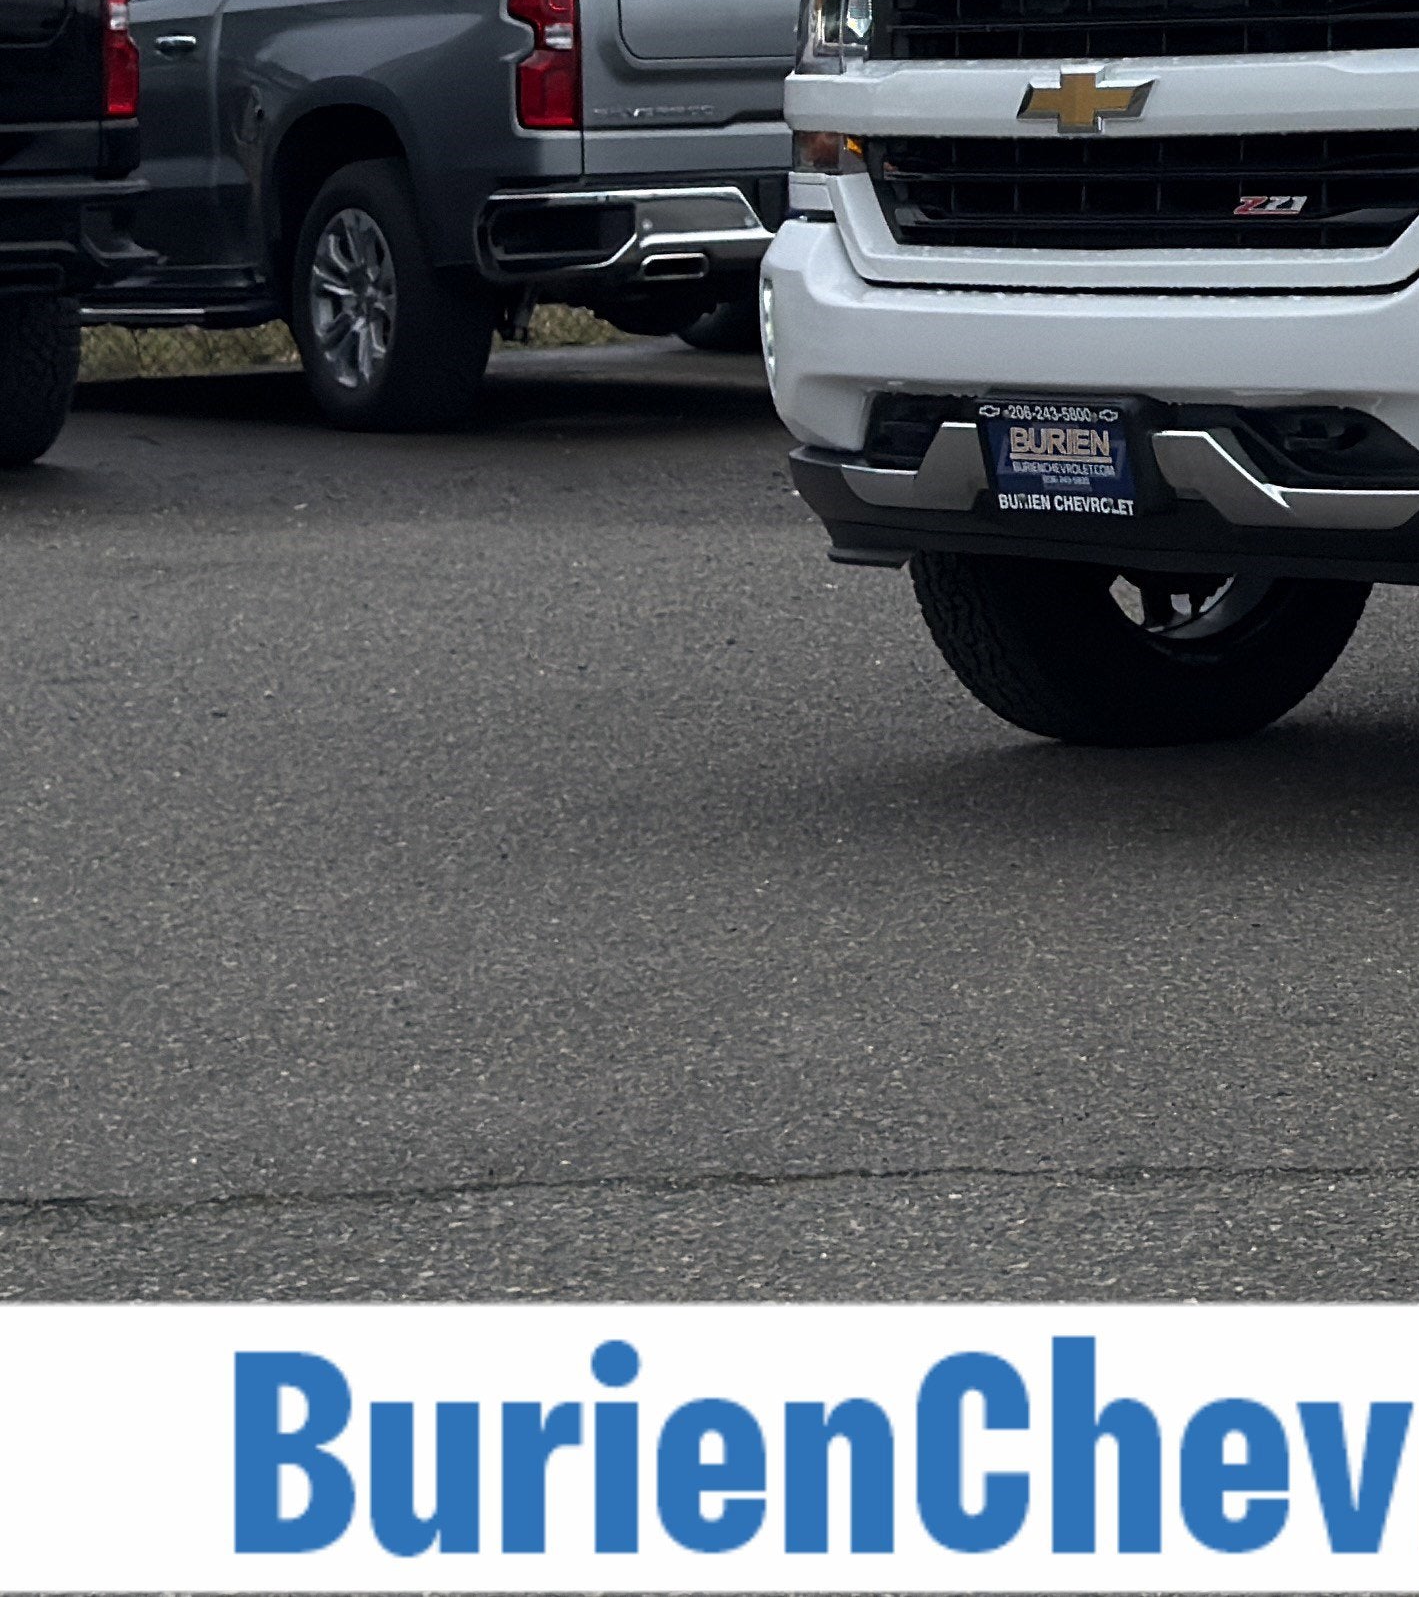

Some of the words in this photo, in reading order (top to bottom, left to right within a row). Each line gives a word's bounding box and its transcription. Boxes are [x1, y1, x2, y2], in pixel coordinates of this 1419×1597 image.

[1233, 195, 1308, 215] Z71
[1007, 404, 1092, 422] 206-243-5800
[1009, 426, 1110, 456] BURIEN
